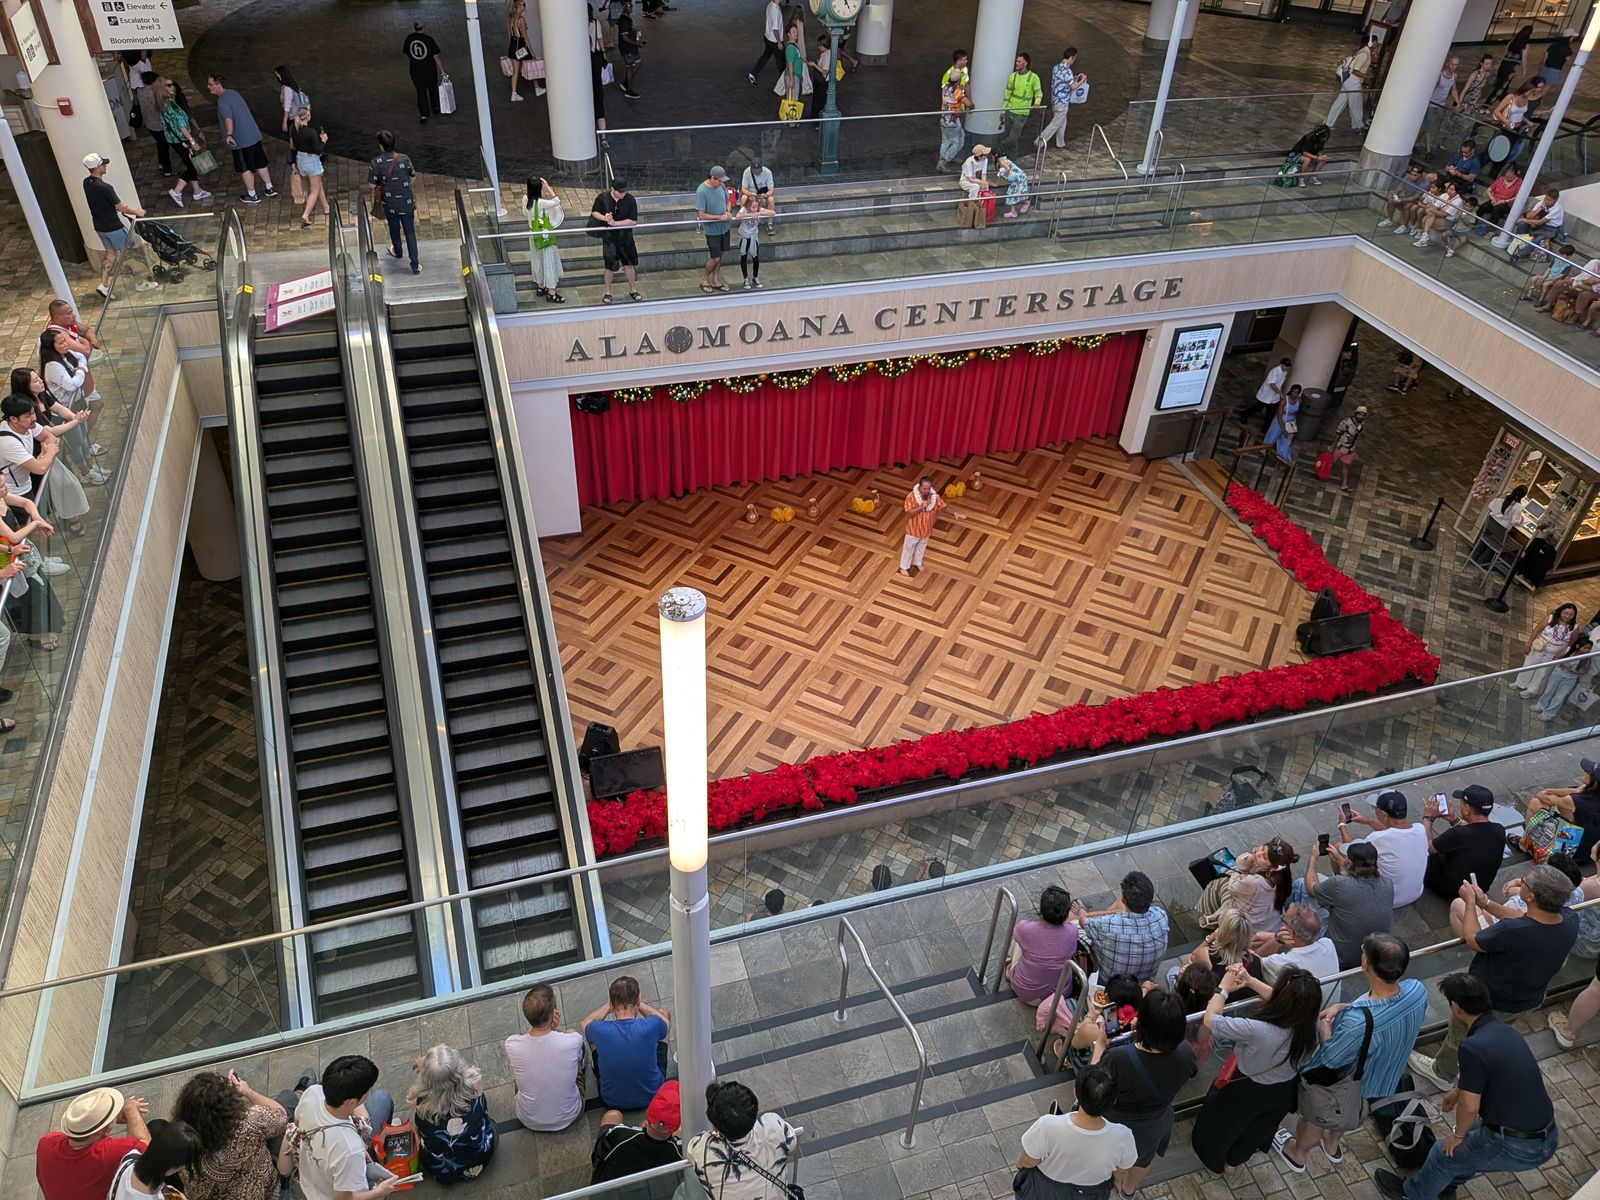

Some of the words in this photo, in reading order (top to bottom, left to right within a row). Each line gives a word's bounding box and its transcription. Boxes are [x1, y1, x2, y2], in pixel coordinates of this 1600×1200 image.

[109, 35, 165, 45] Bloomingdale's
[565, 331, 662, 363] ALA
[697, 311, 854, 350] MOANA
[873, 276, 1184, 331] CENTERSTAGE
[388, 1137, 411, 1147] DARK
